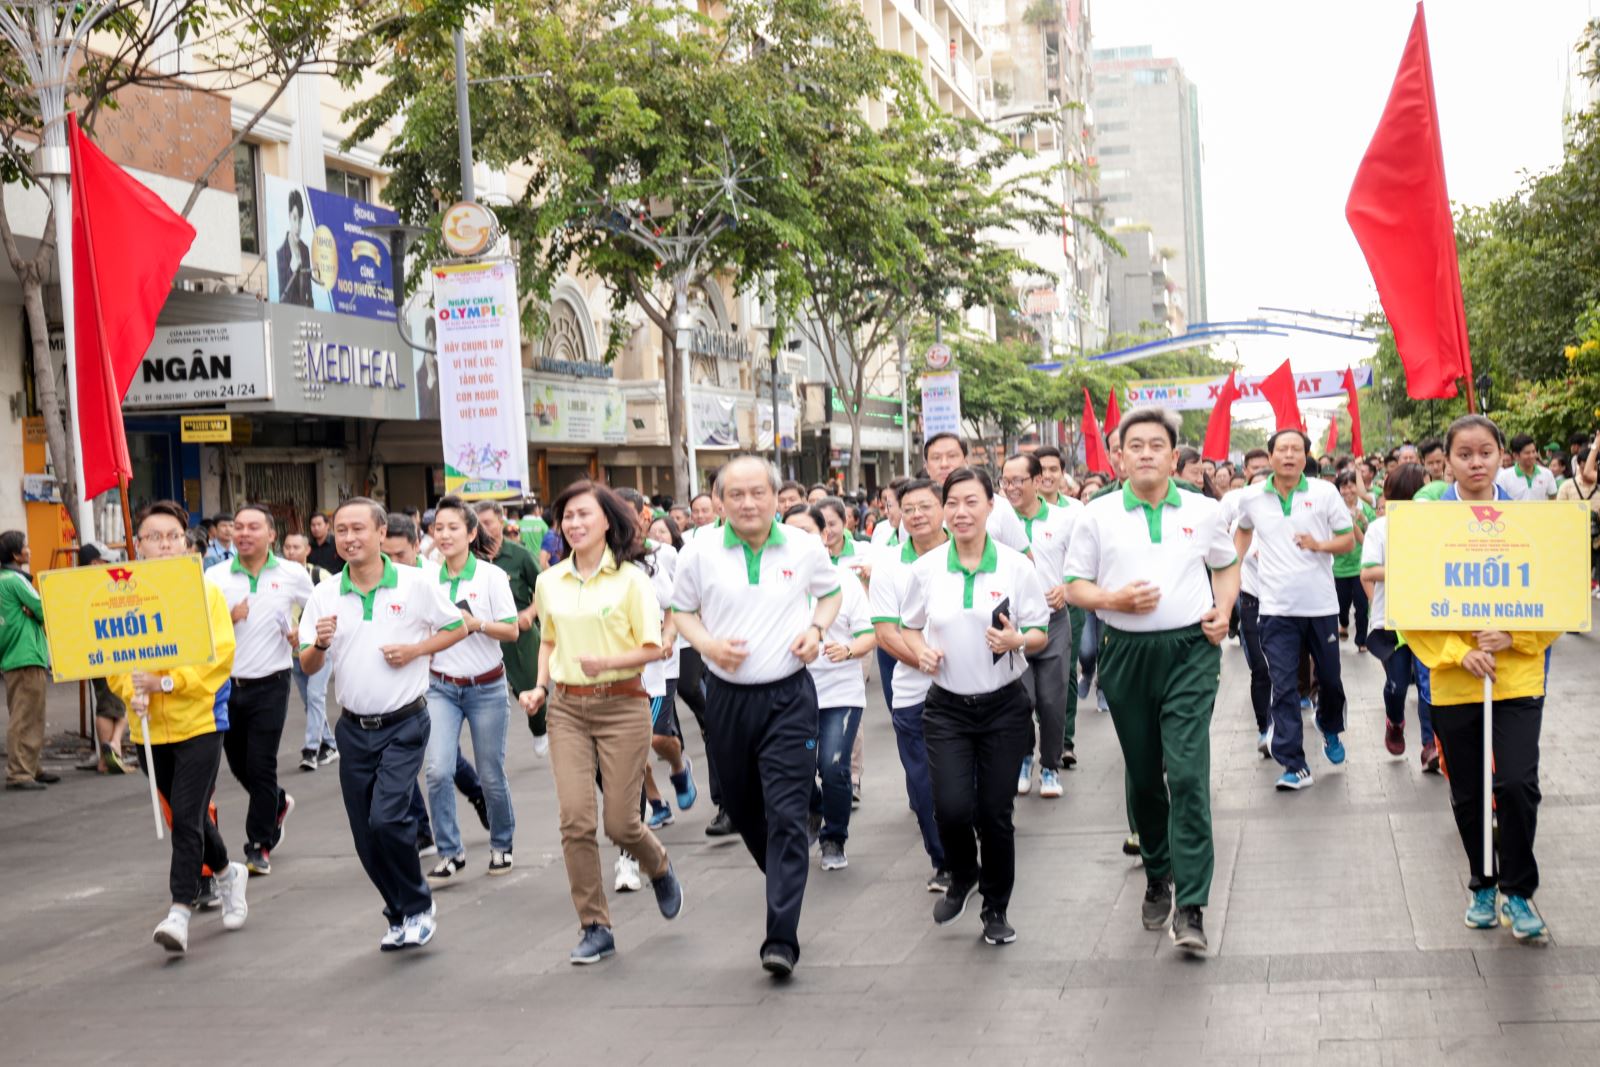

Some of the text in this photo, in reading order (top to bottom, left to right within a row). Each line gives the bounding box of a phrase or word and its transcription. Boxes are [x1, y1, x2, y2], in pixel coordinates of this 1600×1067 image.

[438, 304, 506, 320] OLYMPIC
[461, 340, 488, 352] CHUNG
[491, 338, 504, 349] TAY
[142, 349, 232, 383] NGÂN
[306, 341, 406, 390] MEDIHEAL
[193, 386, 218, 399] OPEN
[1128, 387, 1191, 401] OLYMPIC
[1208, 376, 1260, 399] XẤT
[479, 406, 498, 417] NAM
[1444, 554, 1530, 587] KHỐI 1
[1461, 603, 1491, 618] BAN
[1494, 600, 1544, 618] NGÀNH
[94, 608, 164, 640] KHỐI 1
[113, 648, 137, 663] BAN
[138, 643, 178, 660] NGÀNH
